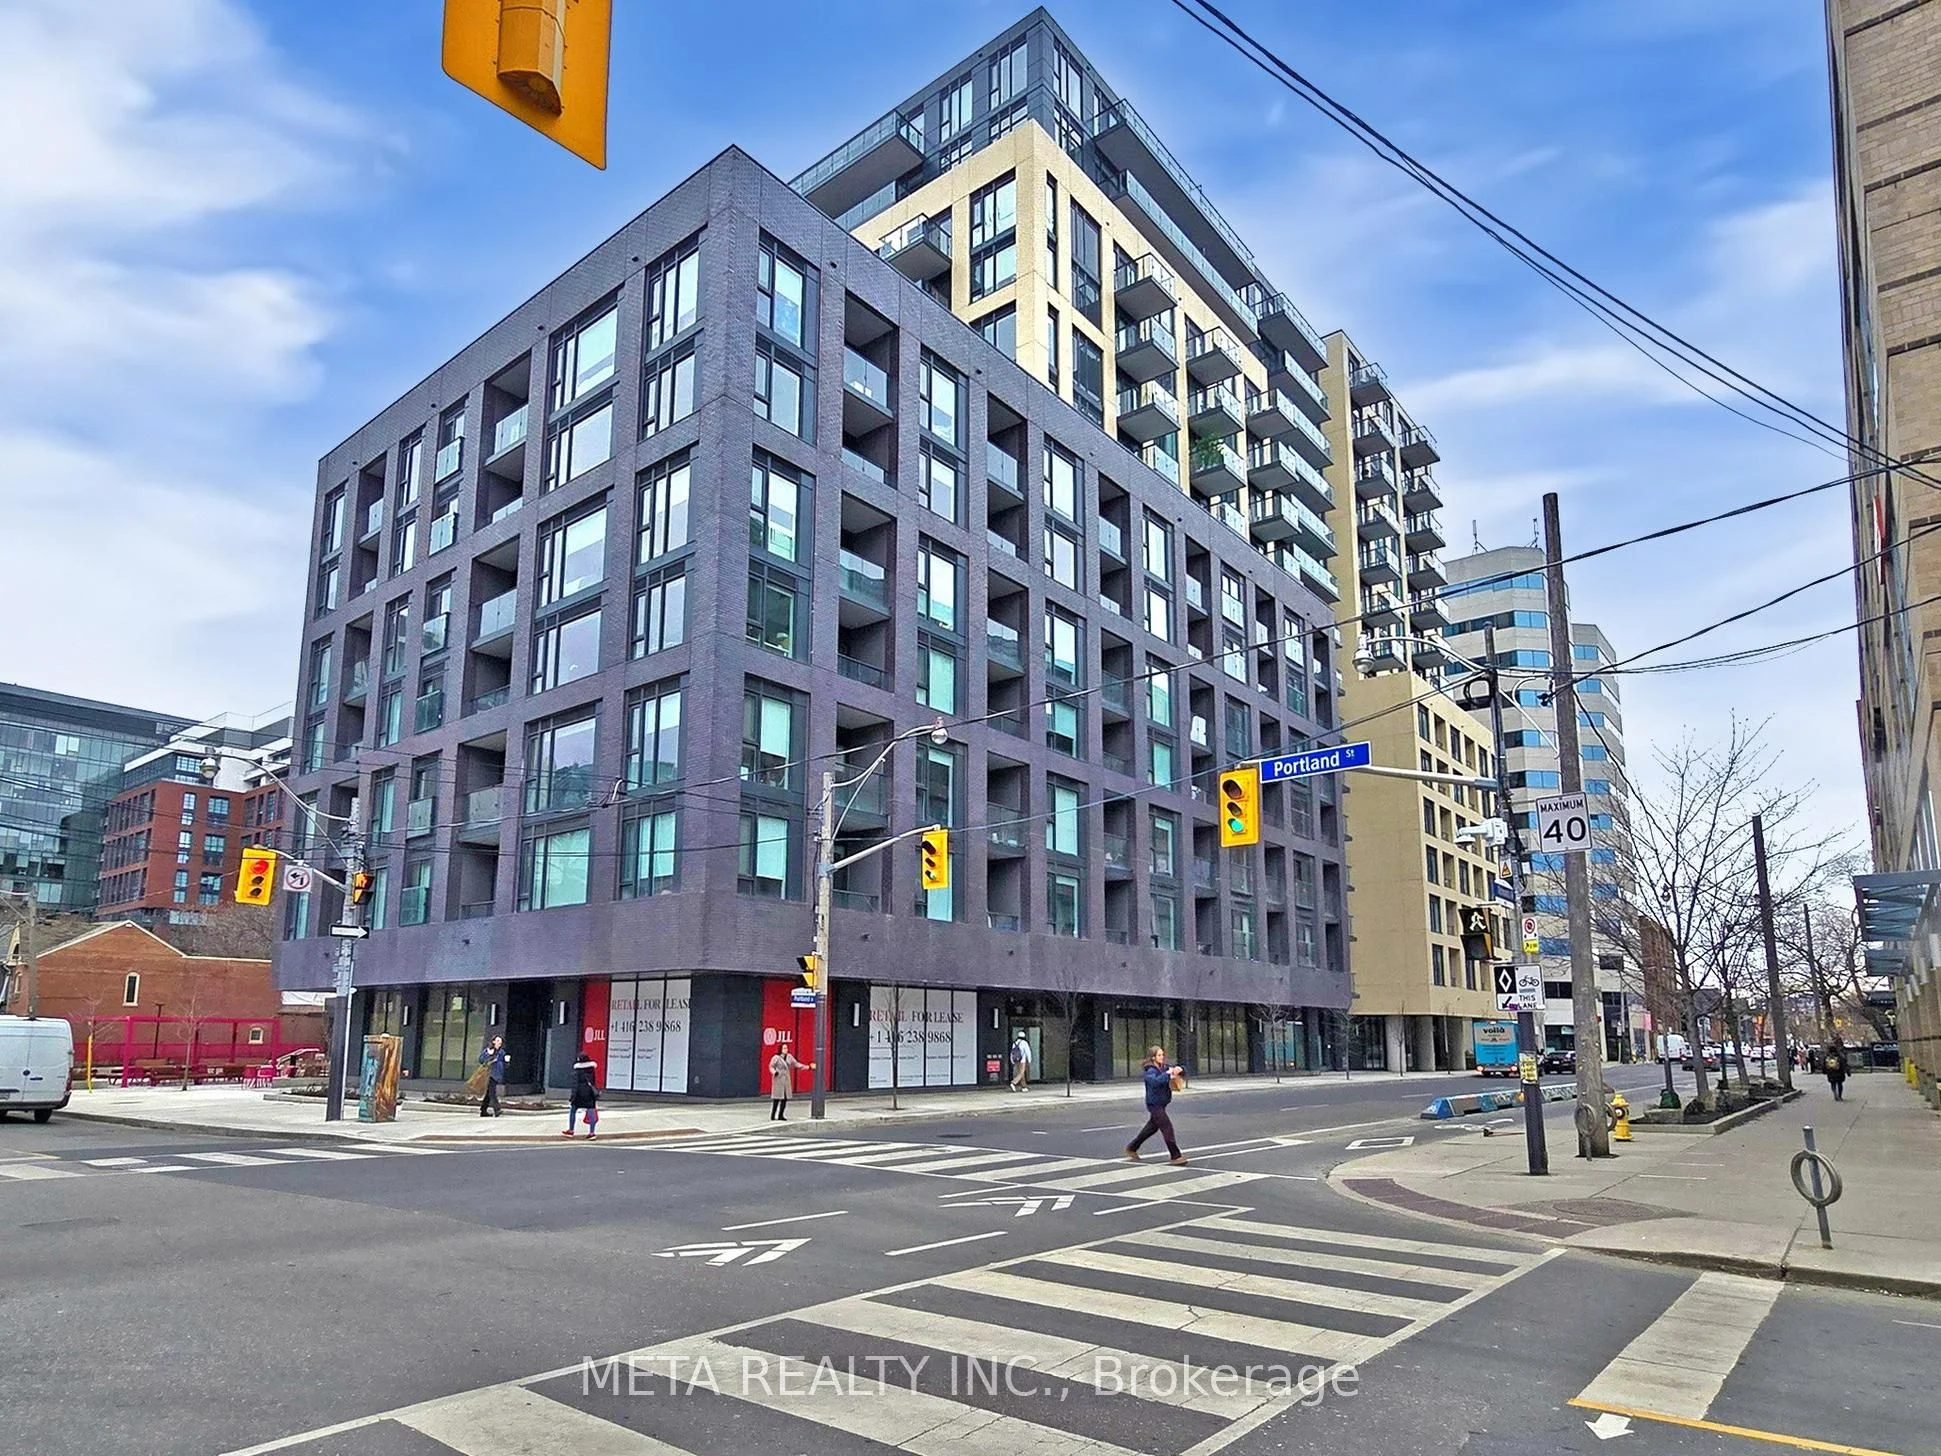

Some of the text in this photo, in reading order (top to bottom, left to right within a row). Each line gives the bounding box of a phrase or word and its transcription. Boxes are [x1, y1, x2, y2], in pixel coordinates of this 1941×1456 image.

[1274, 749, 1355, 776] Portland St
[1540, 799, 1584, 813] MAXIMUM
[1543, 816, 1586, 843] 40
[611, 1000, 642, 1010] RETAL
[643, 1000, 661, 1010] FOR
[1519, 994, 1536, 1002] THIS
[869, 1009, 964, 1023] RETIL FOR LEASE
[621, 1021, 635, 1032] 416
[638, 1020, 654, 1033] 238
[656, 1021, 682, 1033] 9868
[776, 1030, 793, 1043] JLL
[905, 1030, 925, 1044] 238
[927, 1031, 952, 1044] 9868
